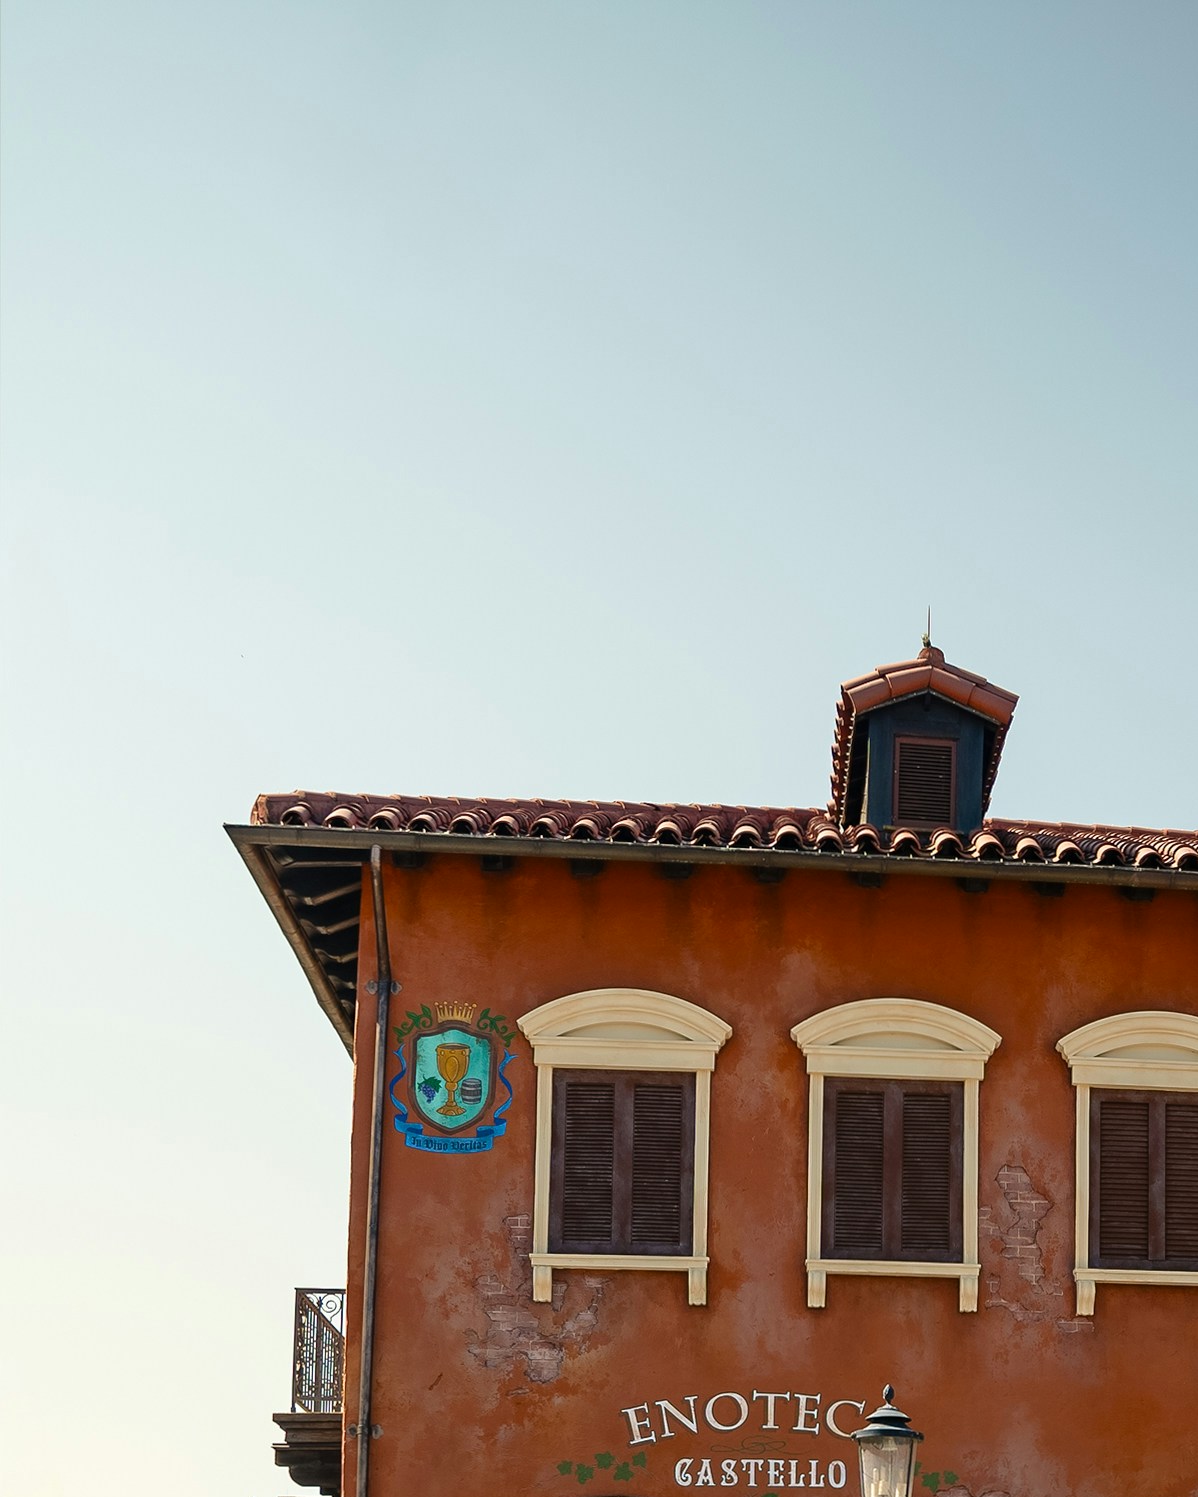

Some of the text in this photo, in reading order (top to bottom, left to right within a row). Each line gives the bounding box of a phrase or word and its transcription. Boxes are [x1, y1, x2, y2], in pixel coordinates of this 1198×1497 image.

[412, 1136, 422, 1147] In
[450, 1140, 487, 1151] Veritas
[621, 1389, 867, 1445] ENOTEC
[674, 1457, 847, 1488] CASTELLO
